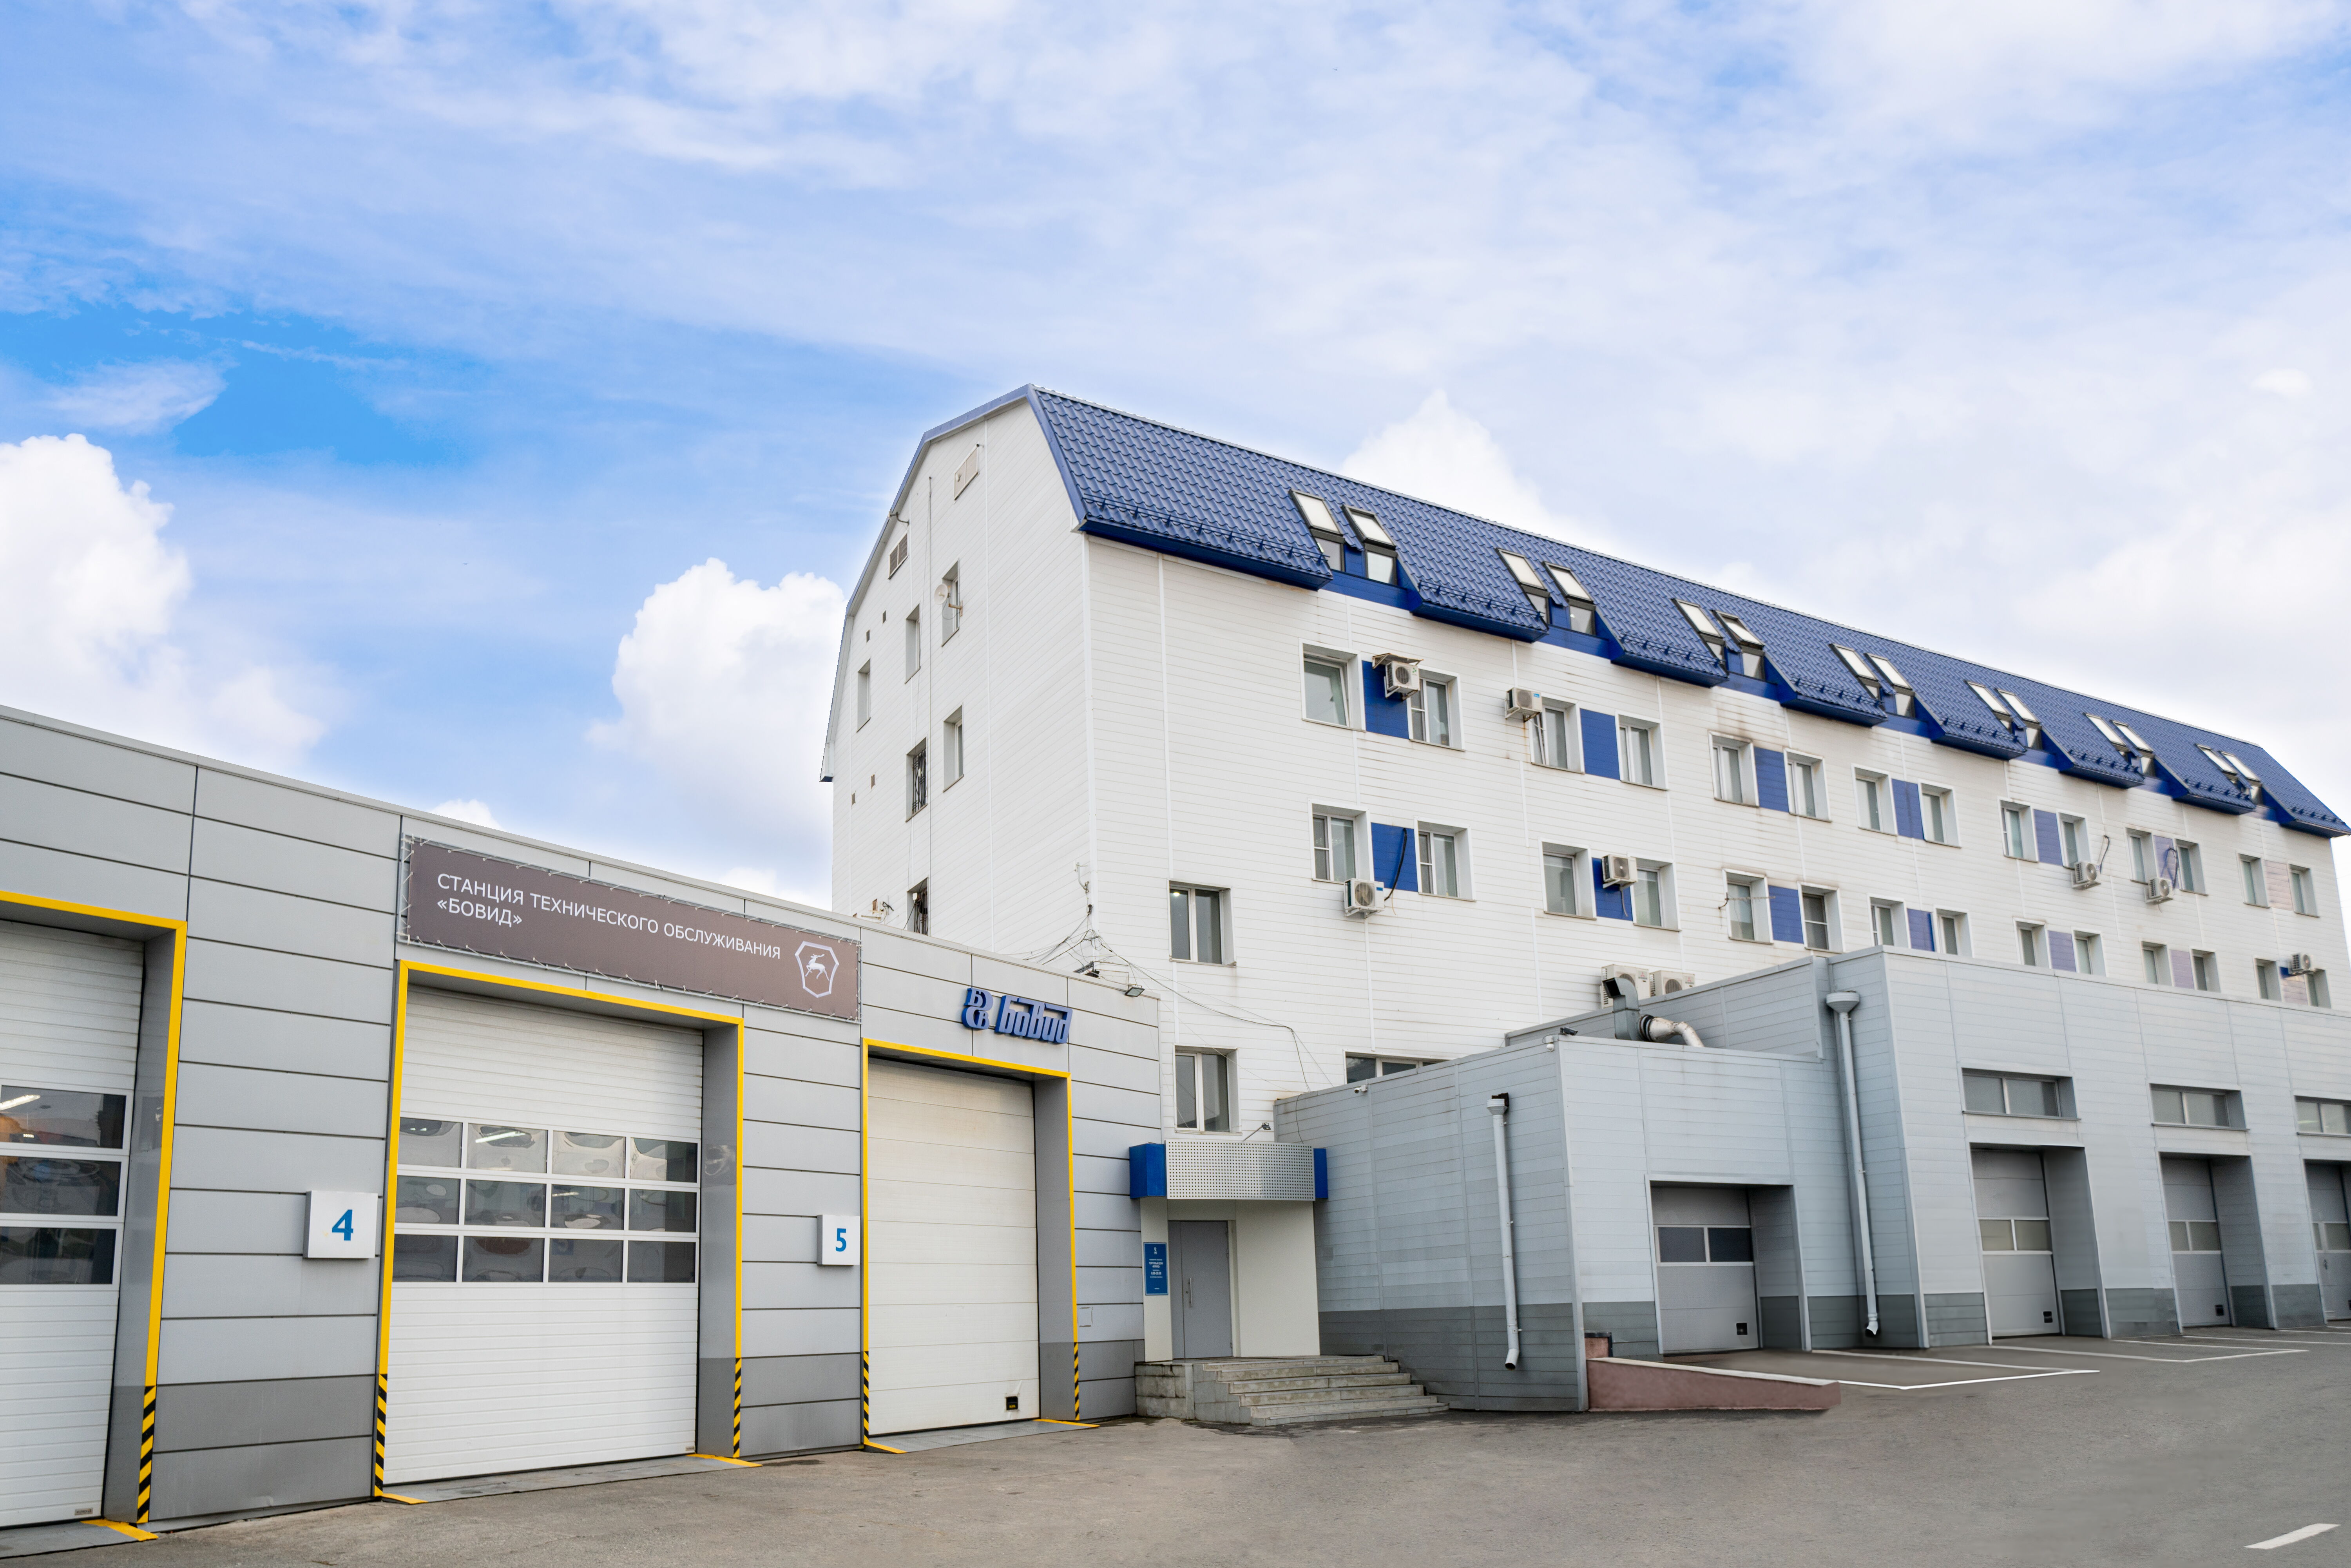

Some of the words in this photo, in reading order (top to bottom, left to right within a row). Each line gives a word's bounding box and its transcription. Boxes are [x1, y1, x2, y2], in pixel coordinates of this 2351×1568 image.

[437, 898, 522, 928] «БОВИД»
[438, 873, 523, 905] СТАНЦИЯ
[530, 893, 658, 933] ТЕХНИЧЕСКОГО
[664, 923, 780, 959] ОБСЛУЖИВАНИЯ
[332, 1209, 353, 1241] 4
[835, 1228, 846, 1252] 5
